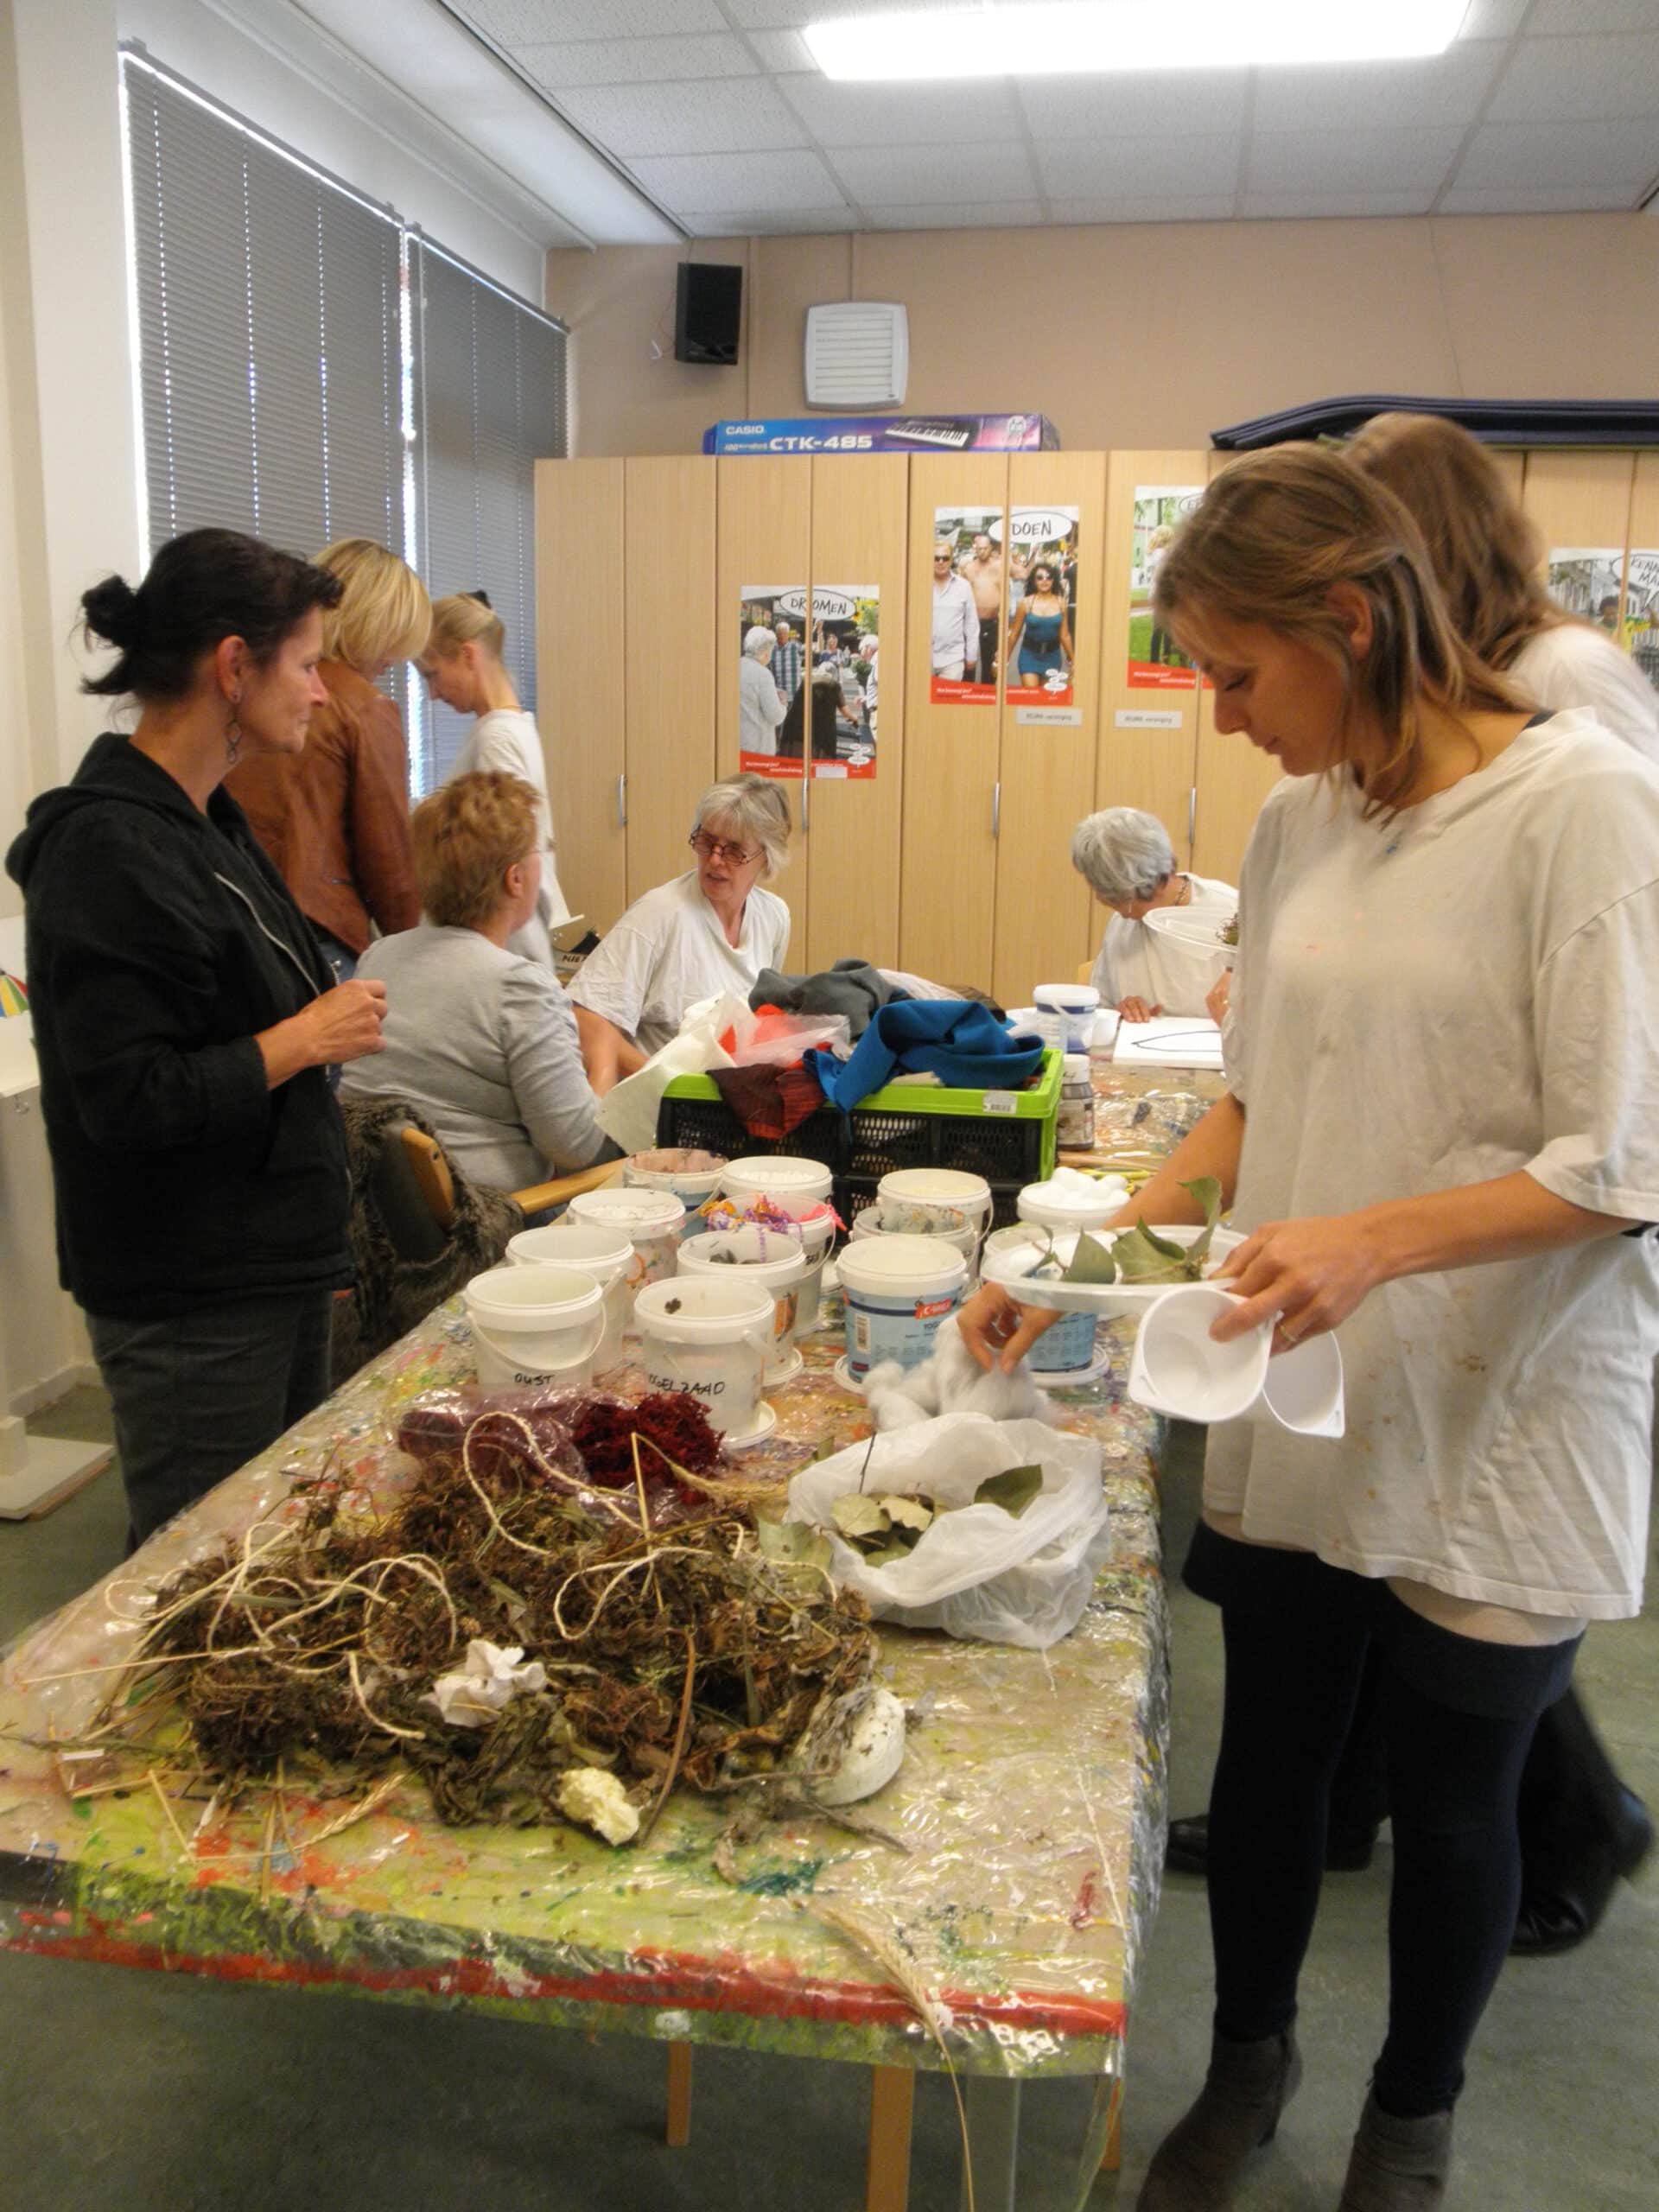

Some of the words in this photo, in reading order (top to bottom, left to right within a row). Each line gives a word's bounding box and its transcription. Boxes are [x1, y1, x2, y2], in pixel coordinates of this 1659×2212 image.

[726, 425, 765, 435] CASIO
[770, 435, 873, 451] CTK-485
[1012, 519, 1052, 537] DOEN
[1637, 571, 1659, 586] MA
[790, 596, 847, 615] DROMEN
